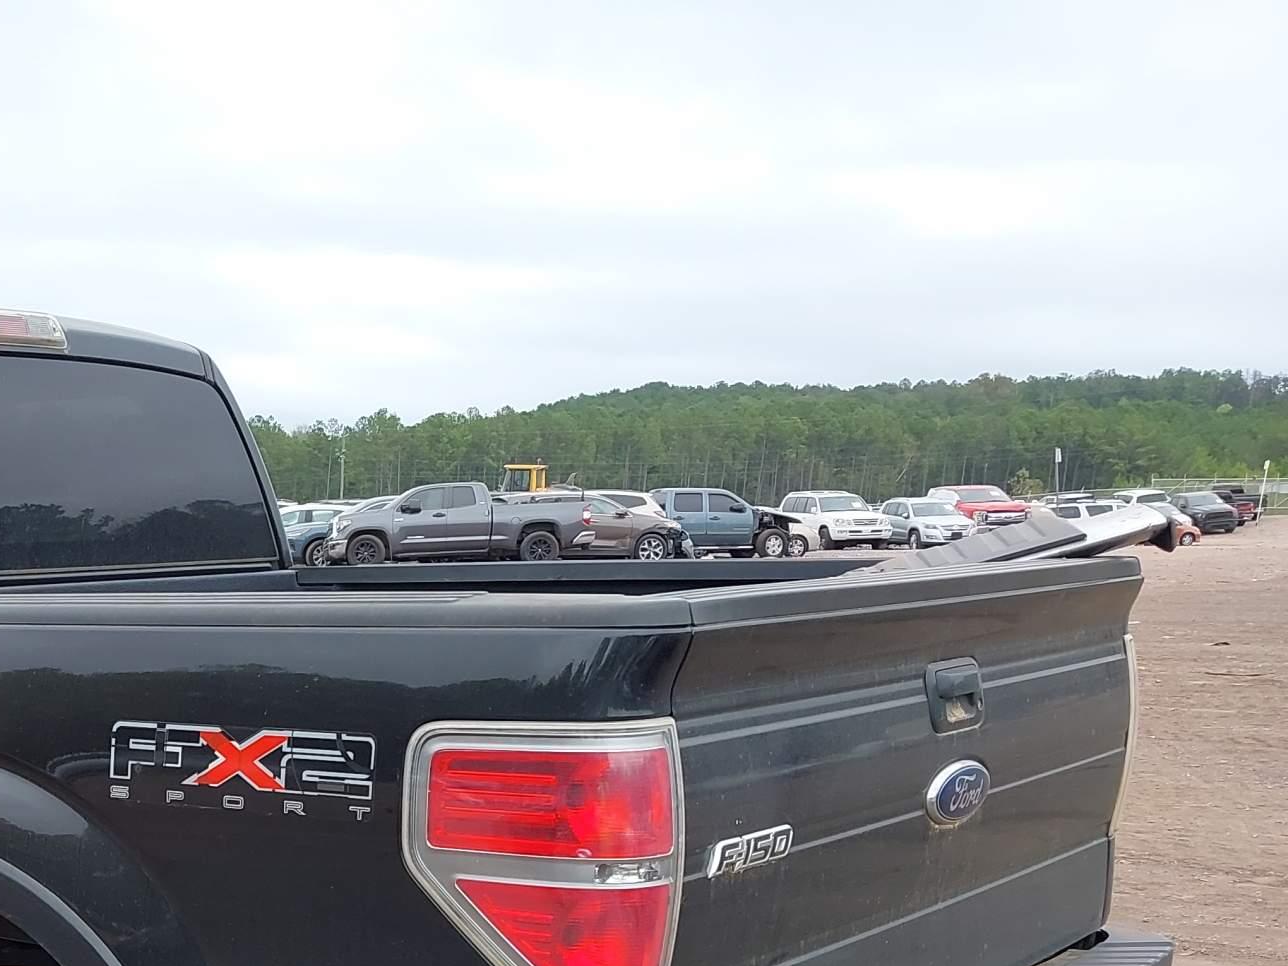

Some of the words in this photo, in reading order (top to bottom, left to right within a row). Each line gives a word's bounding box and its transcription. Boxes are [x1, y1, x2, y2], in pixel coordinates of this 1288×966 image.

[109, 720, 376, 800] FX2
[109, 784, 371, 821] SPORT
[949, 773, 984, 812] Ford
